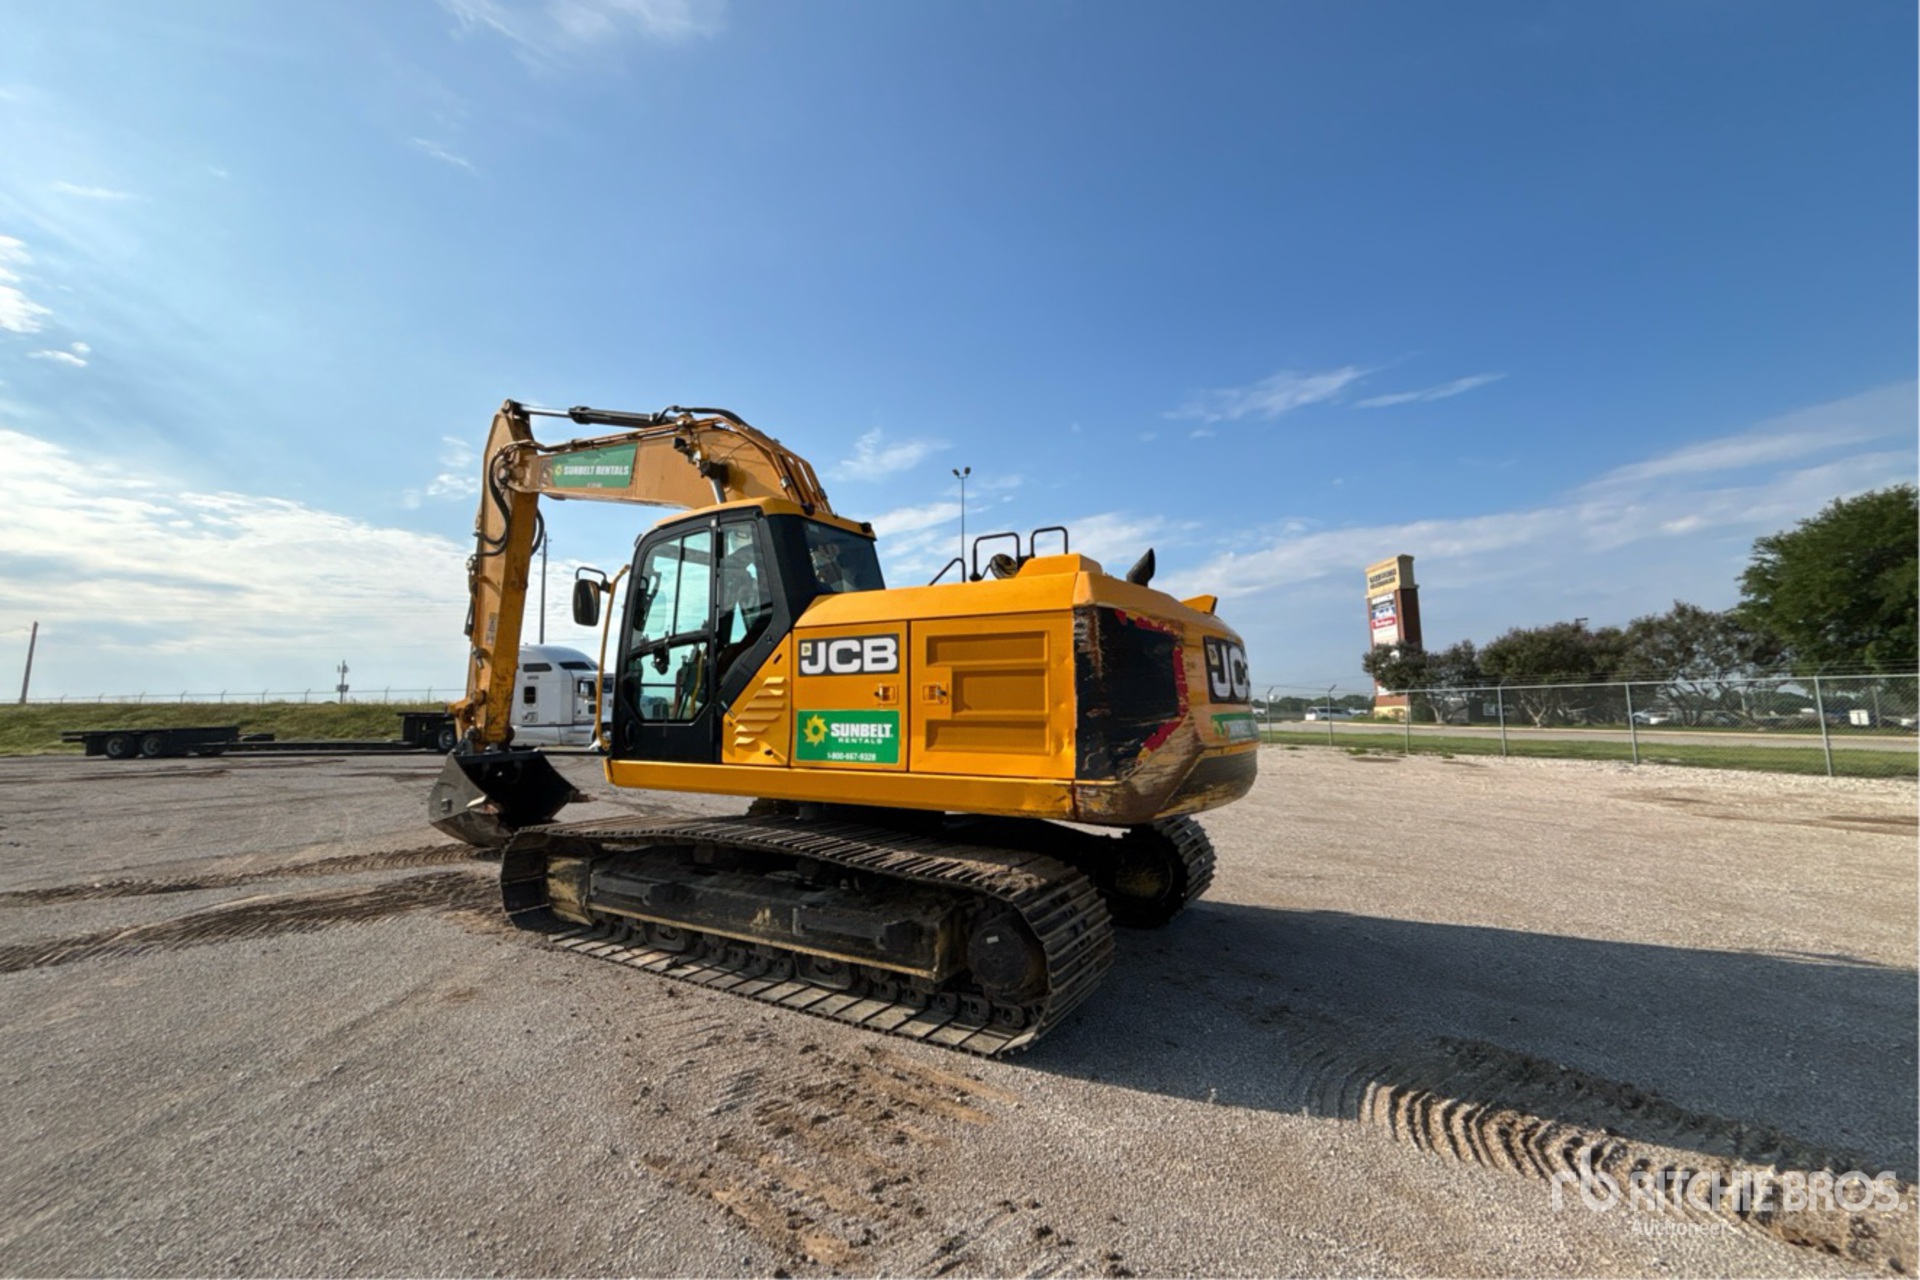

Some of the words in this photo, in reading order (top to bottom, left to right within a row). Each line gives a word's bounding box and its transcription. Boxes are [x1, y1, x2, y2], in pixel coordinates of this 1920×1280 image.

[563, 465, 595, 475] SUNBELT
[596, 465, 629, 475] RENTALS
[801, 637, 897, 674] JCB
[830, 723, 893, 737] SUNBELT
